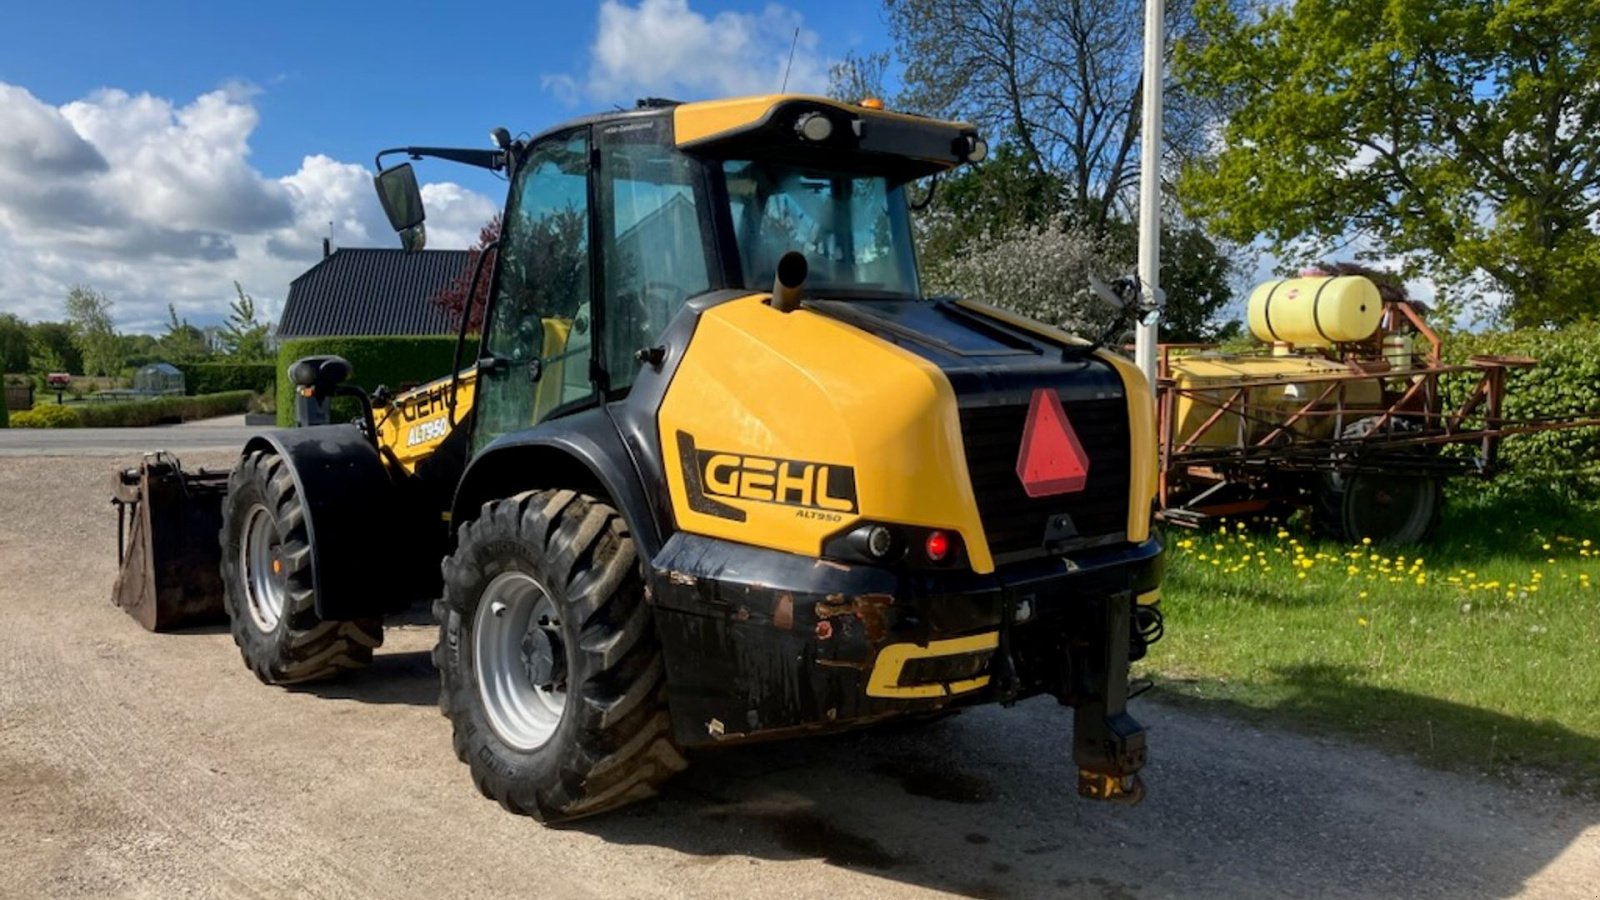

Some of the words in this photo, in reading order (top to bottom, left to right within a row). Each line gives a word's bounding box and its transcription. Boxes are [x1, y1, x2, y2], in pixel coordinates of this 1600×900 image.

[408, 417, 447, 445] ALT950
[705, 454, 853, 511] GEHL
[796, 509, 842, 522] ALT950
